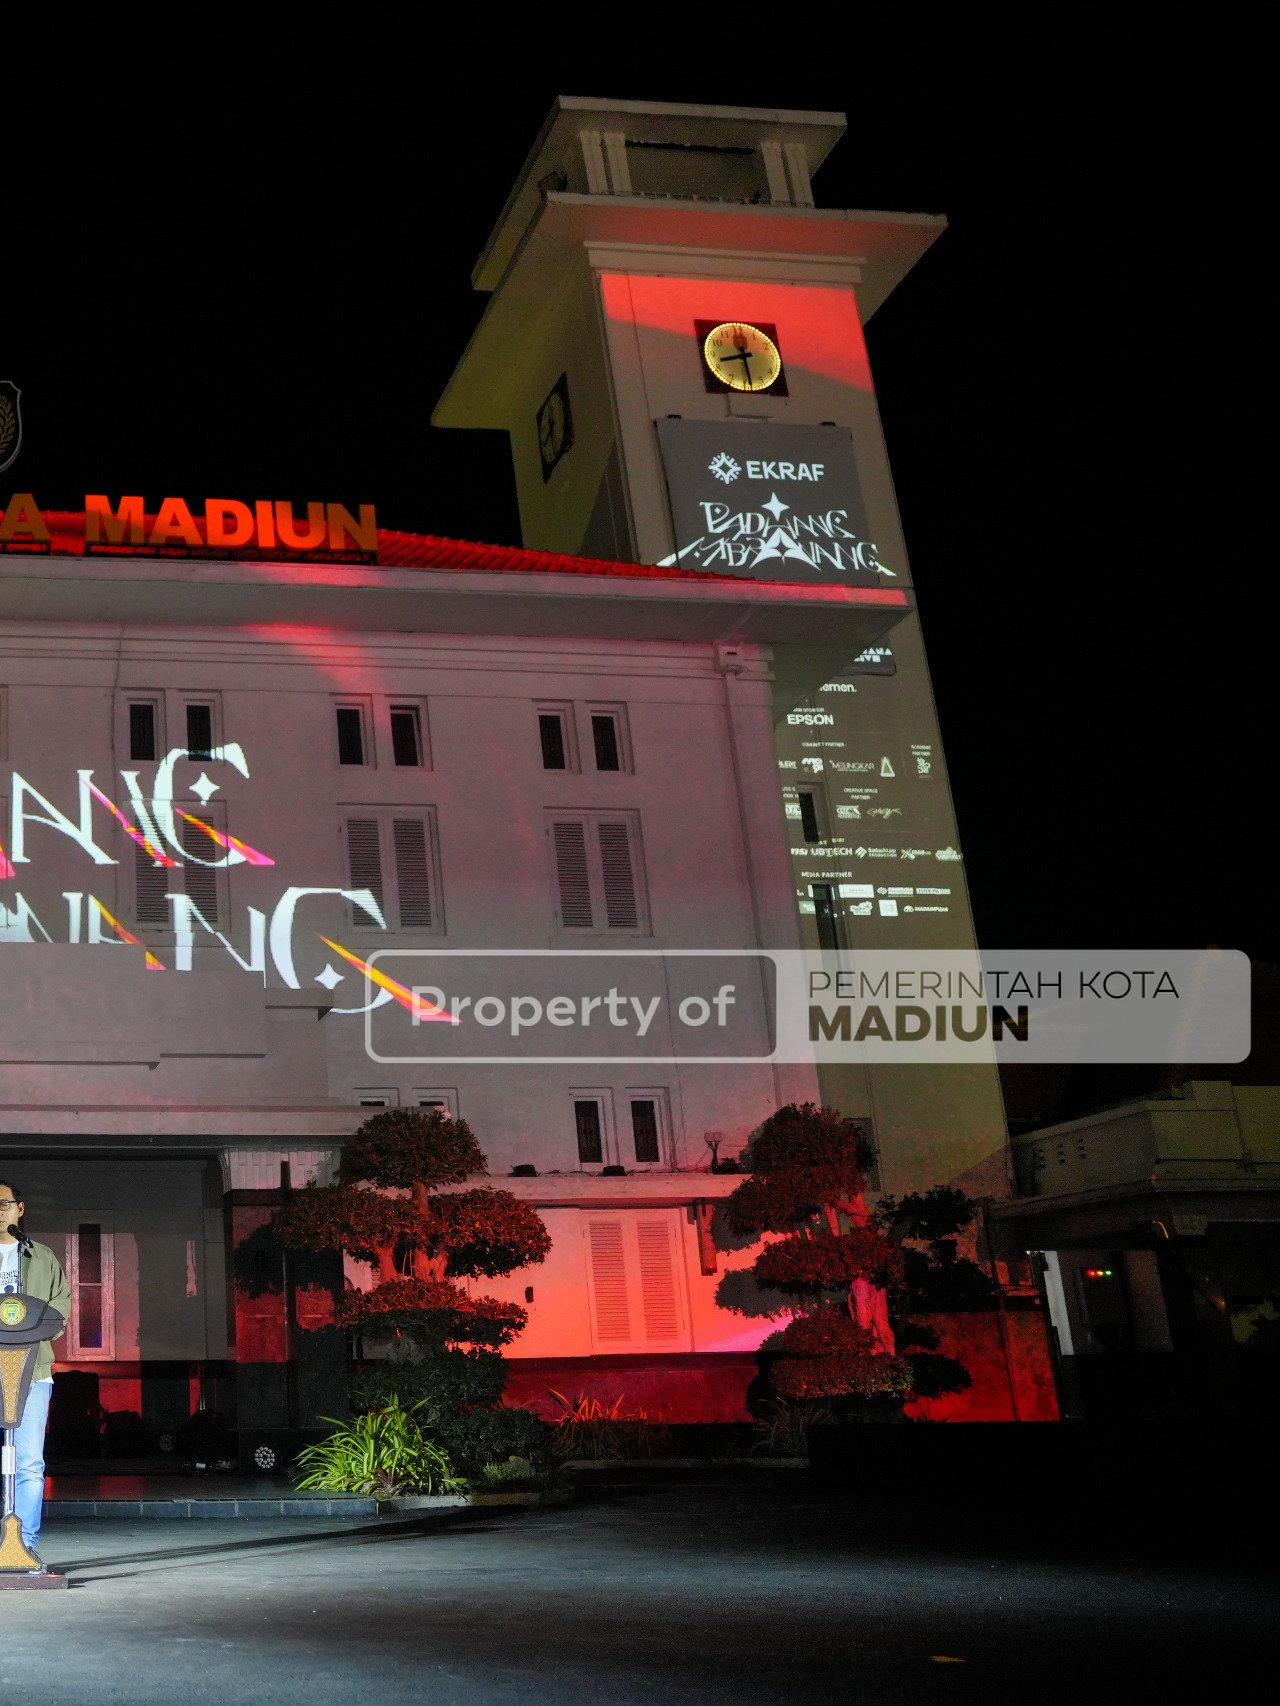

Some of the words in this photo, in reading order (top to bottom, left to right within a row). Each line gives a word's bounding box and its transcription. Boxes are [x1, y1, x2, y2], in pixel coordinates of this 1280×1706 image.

[747, 460, 825, 482] EKRAF
[84, 494, 378, 552] MADIUN
[787, 713, 835, 726] EPSON
[810, 847, 853, 857] UBTECH
